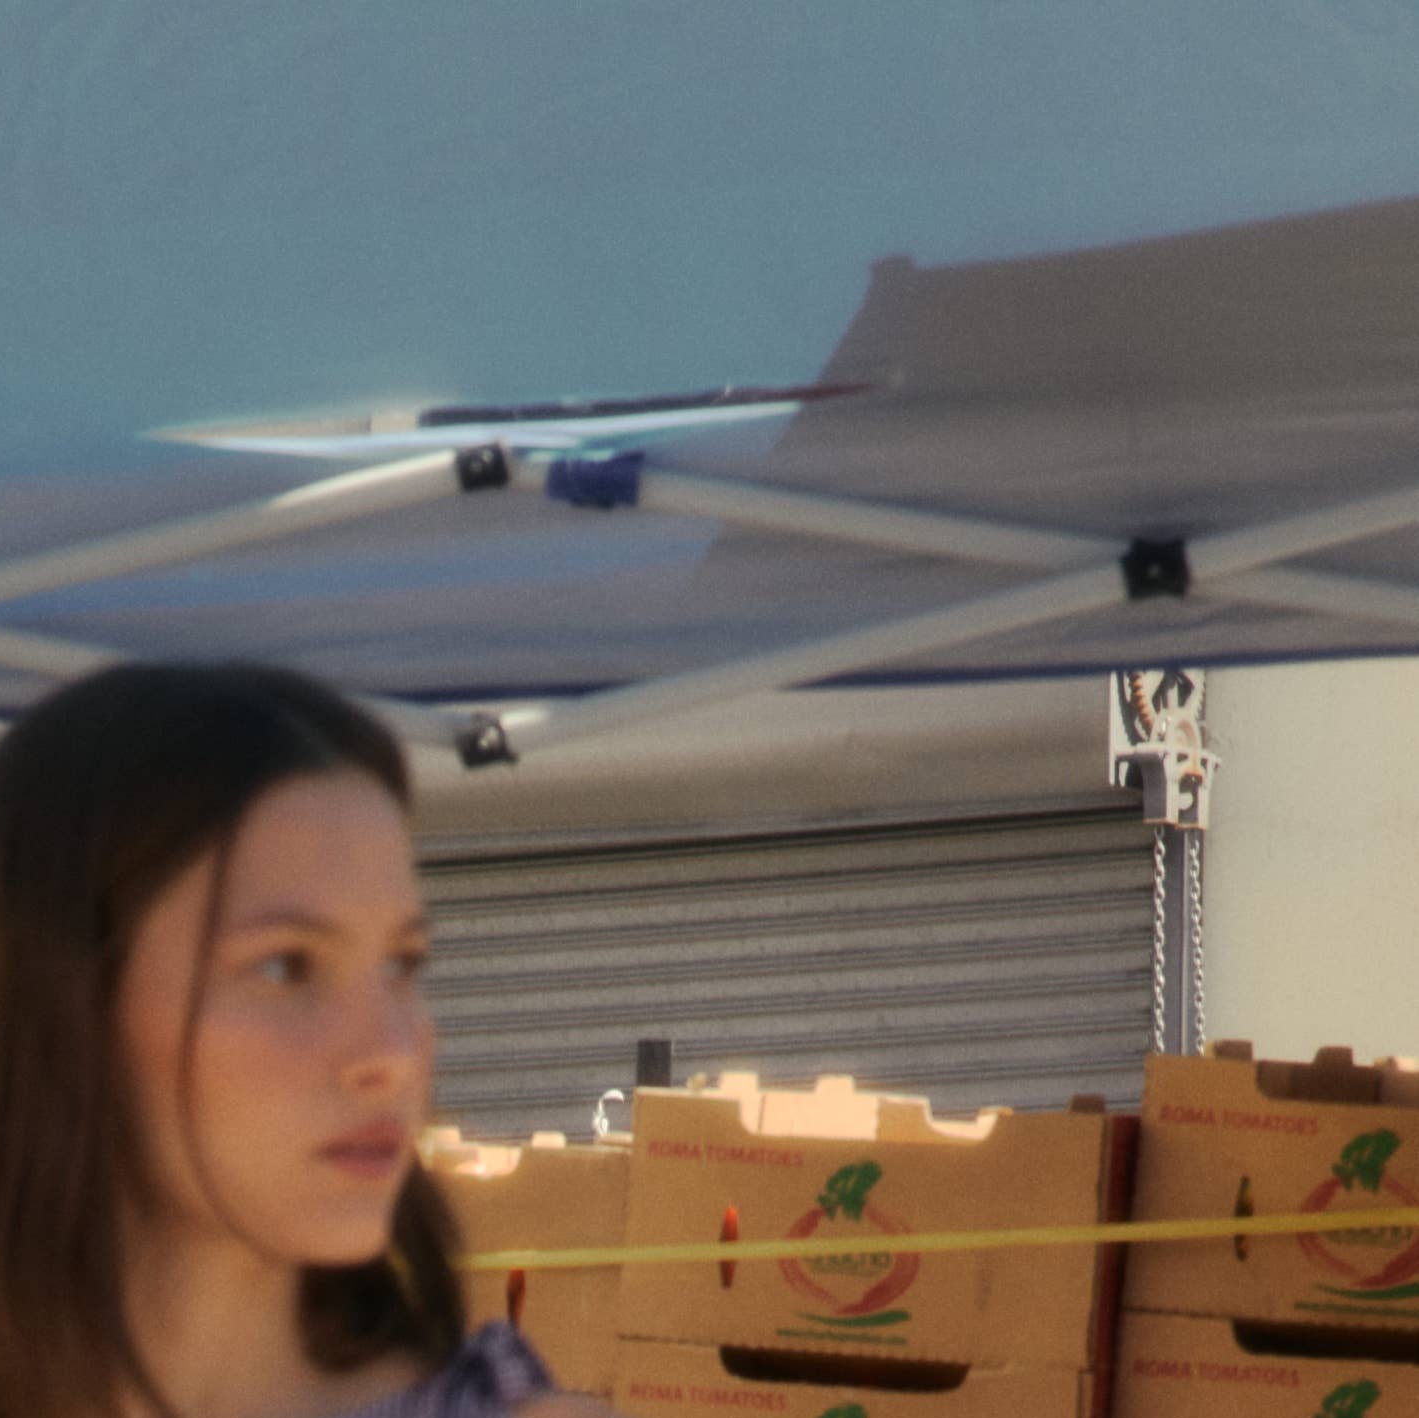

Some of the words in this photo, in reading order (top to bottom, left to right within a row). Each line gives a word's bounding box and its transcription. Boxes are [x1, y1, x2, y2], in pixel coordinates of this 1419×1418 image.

[1159, 1104, 1215, 1124] ROMA
[647, 1140, 701, 1159] ROMA
[1133, 1358, 1191, 1378] ROMA
[629, 1383, 683, 1402] ROMA
